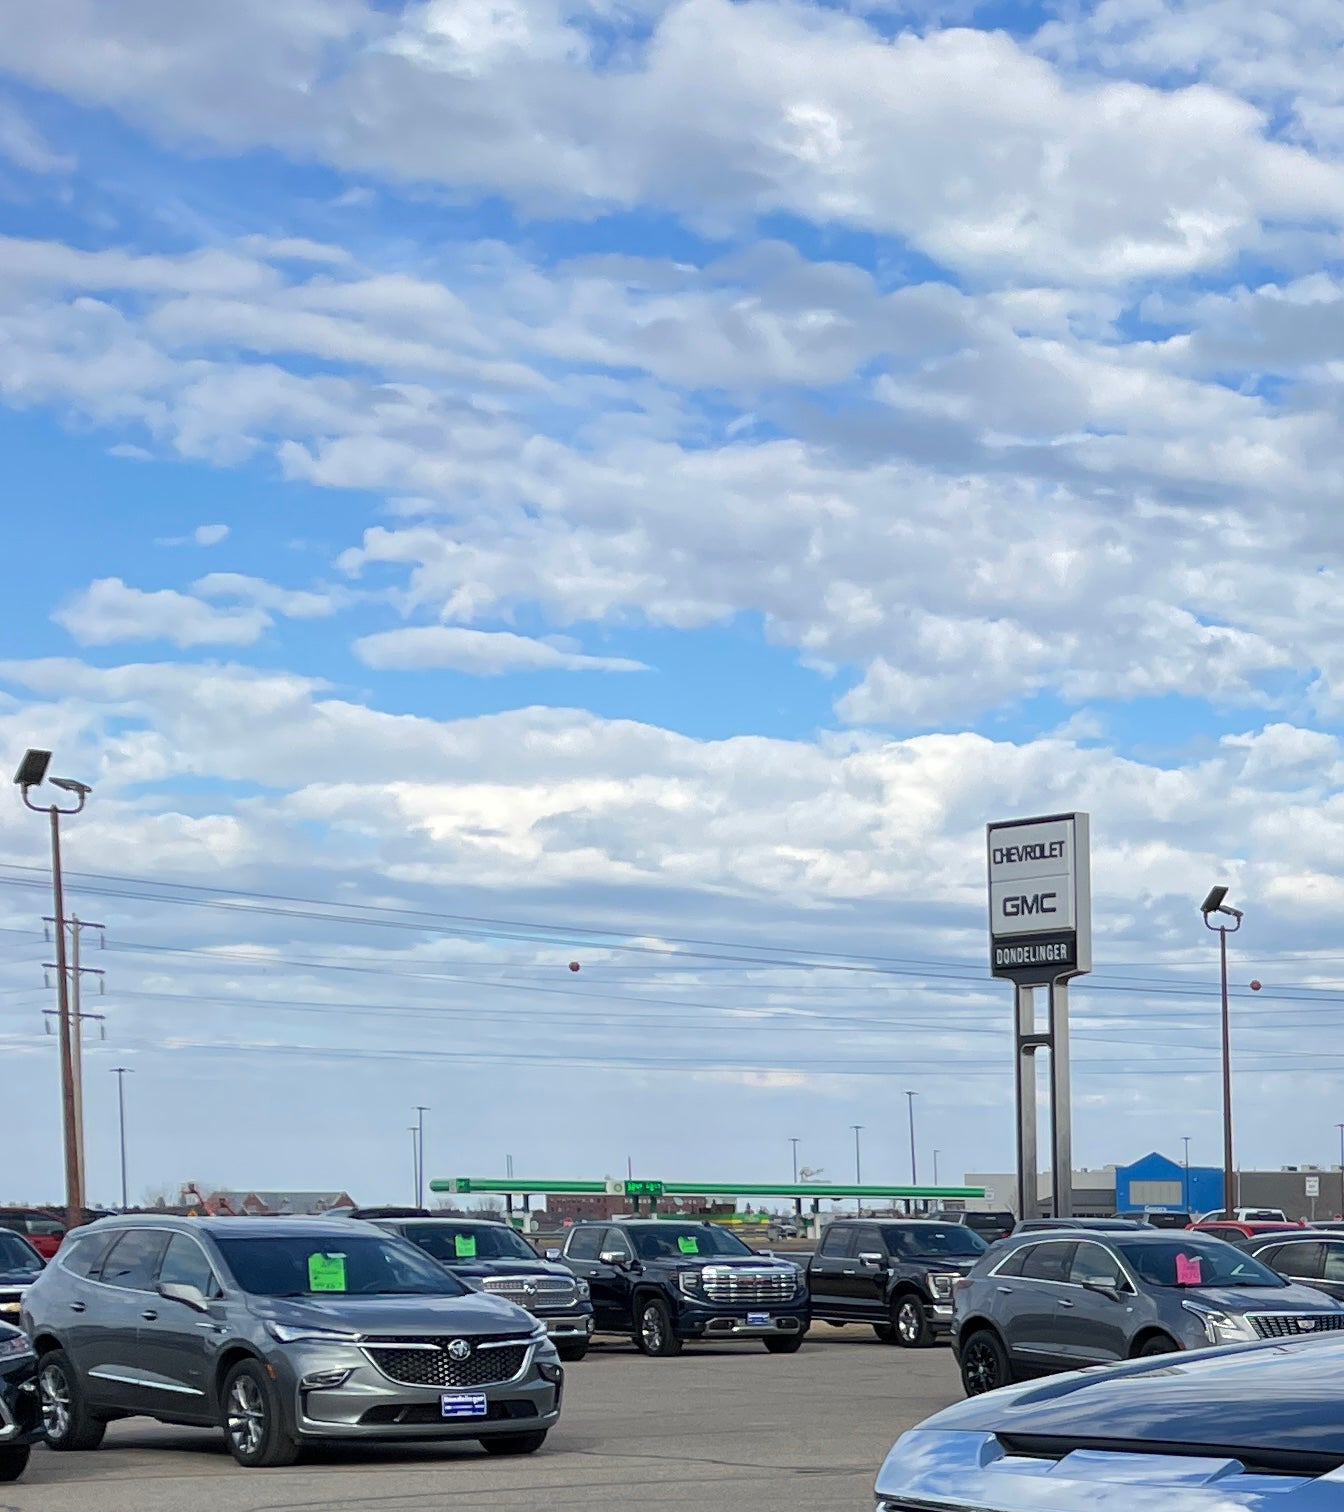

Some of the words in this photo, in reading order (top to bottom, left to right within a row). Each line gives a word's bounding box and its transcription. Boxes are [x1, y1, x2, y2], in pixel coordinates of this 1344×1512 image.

[993, 841, 1065, 865] CHEVROLET
[1003, 893, 1057, 917] GMC
[996, 943, 1068, 965] DONDELINGER
